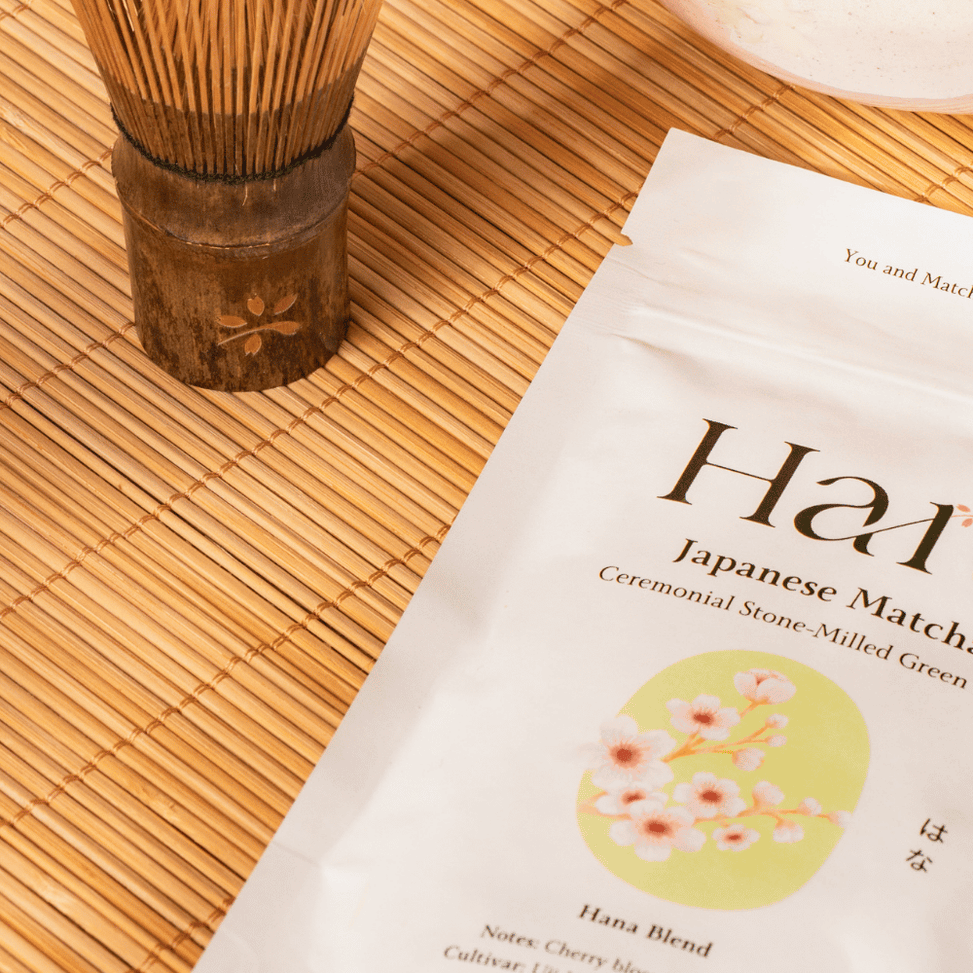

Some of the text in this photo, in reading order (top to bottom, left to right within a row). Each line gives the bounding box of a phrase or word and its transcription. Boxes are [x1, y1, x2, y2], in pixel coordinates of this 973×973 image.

[845, 248, 878, 271] You
[882, 265, 919, 282] and
[672, 537, 838, 603] Japanese
[598, 565, 736, 612] Ceremonial
[738, 600, 894, 662] Stone-Milled
[899, 652, 968, 691] Green
[905, 818, 949, 873] はな
[443, 944, 527, 973] Cultivar:
[480, 924, 538, 950] Notes:
[544, 939, 608, 970] Cherry
[578, 903, 714, 959] Hana Blend
